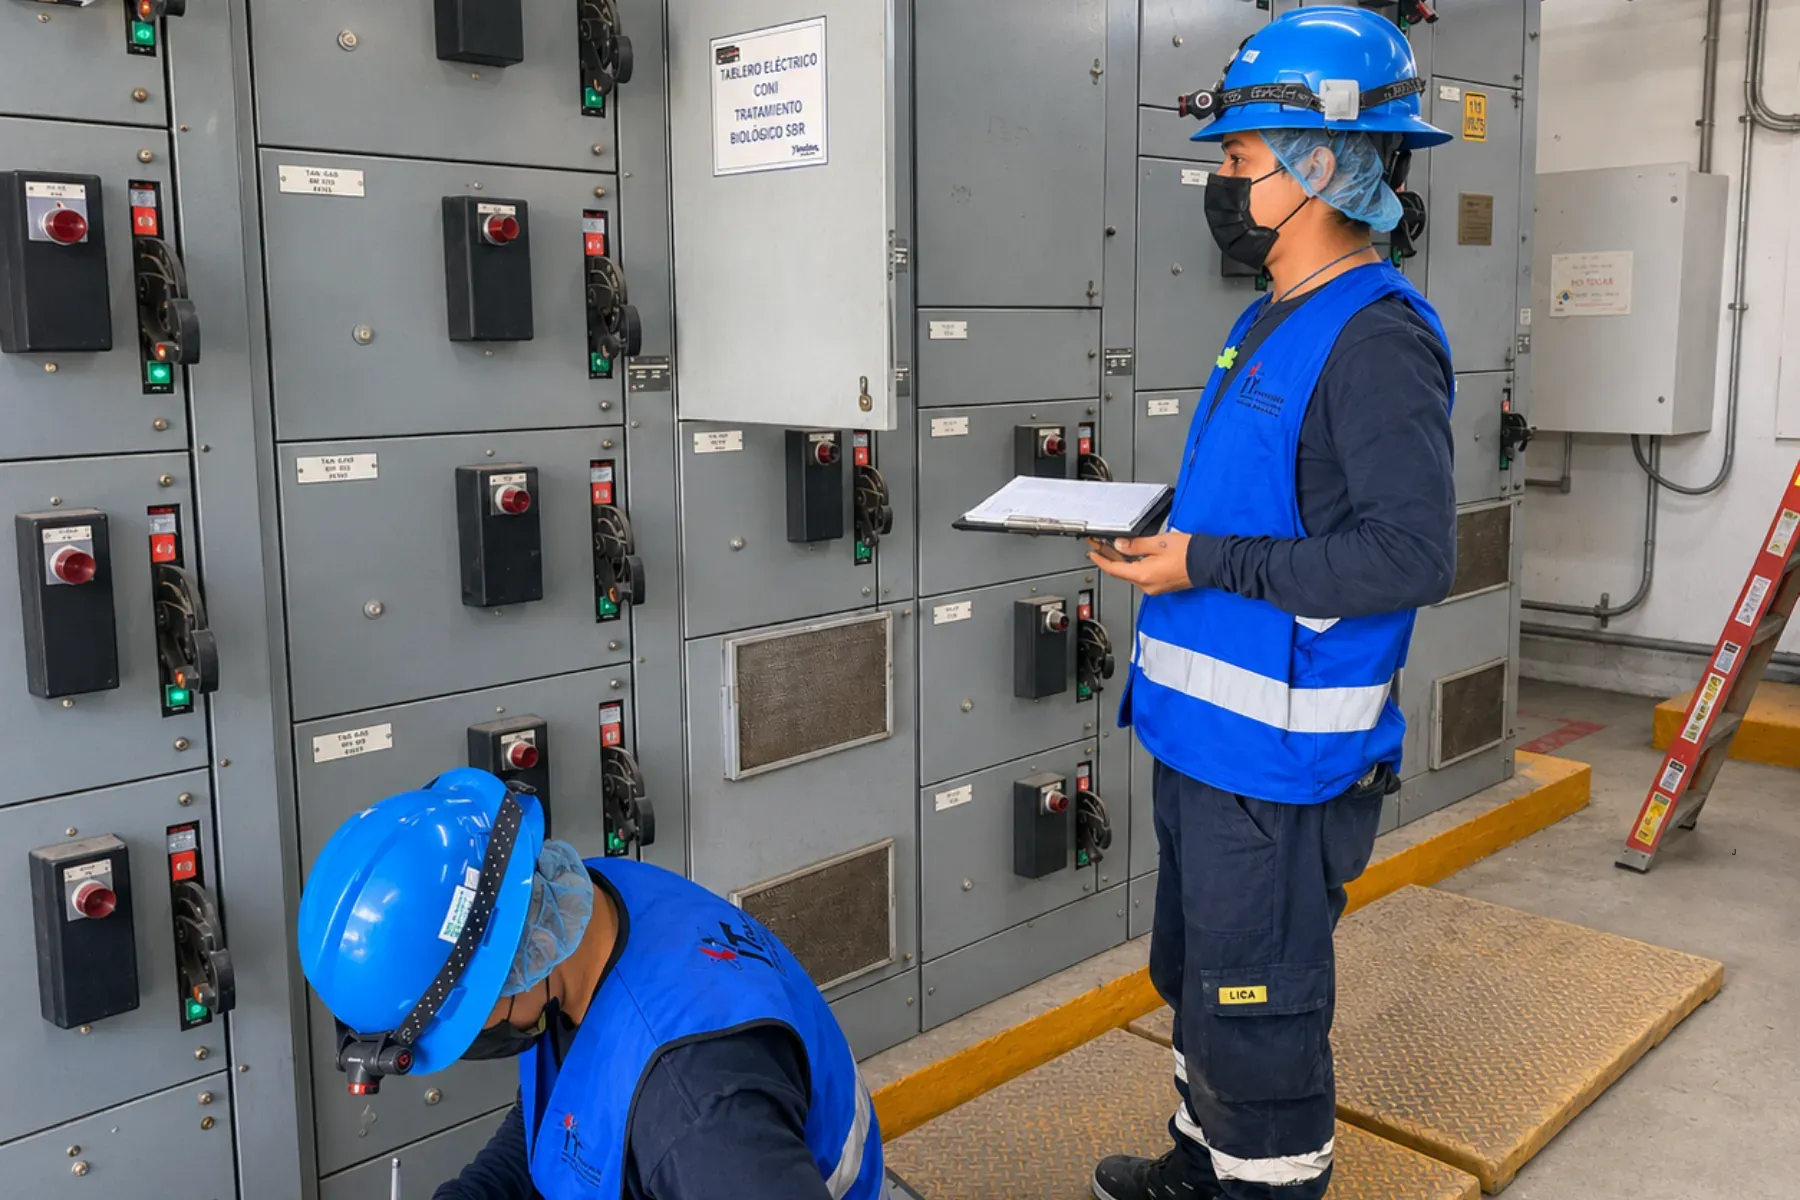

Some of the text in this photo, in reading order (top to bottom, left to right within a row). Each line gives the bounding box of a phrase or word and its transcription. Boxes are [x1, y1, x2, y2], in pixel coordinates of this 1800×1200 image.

[764, 52, 818, 74] ELÉCTRICO
[734, 100, 803, 122] TRATAMIENTO
[1229, 990, 1256, 1000] LICA
